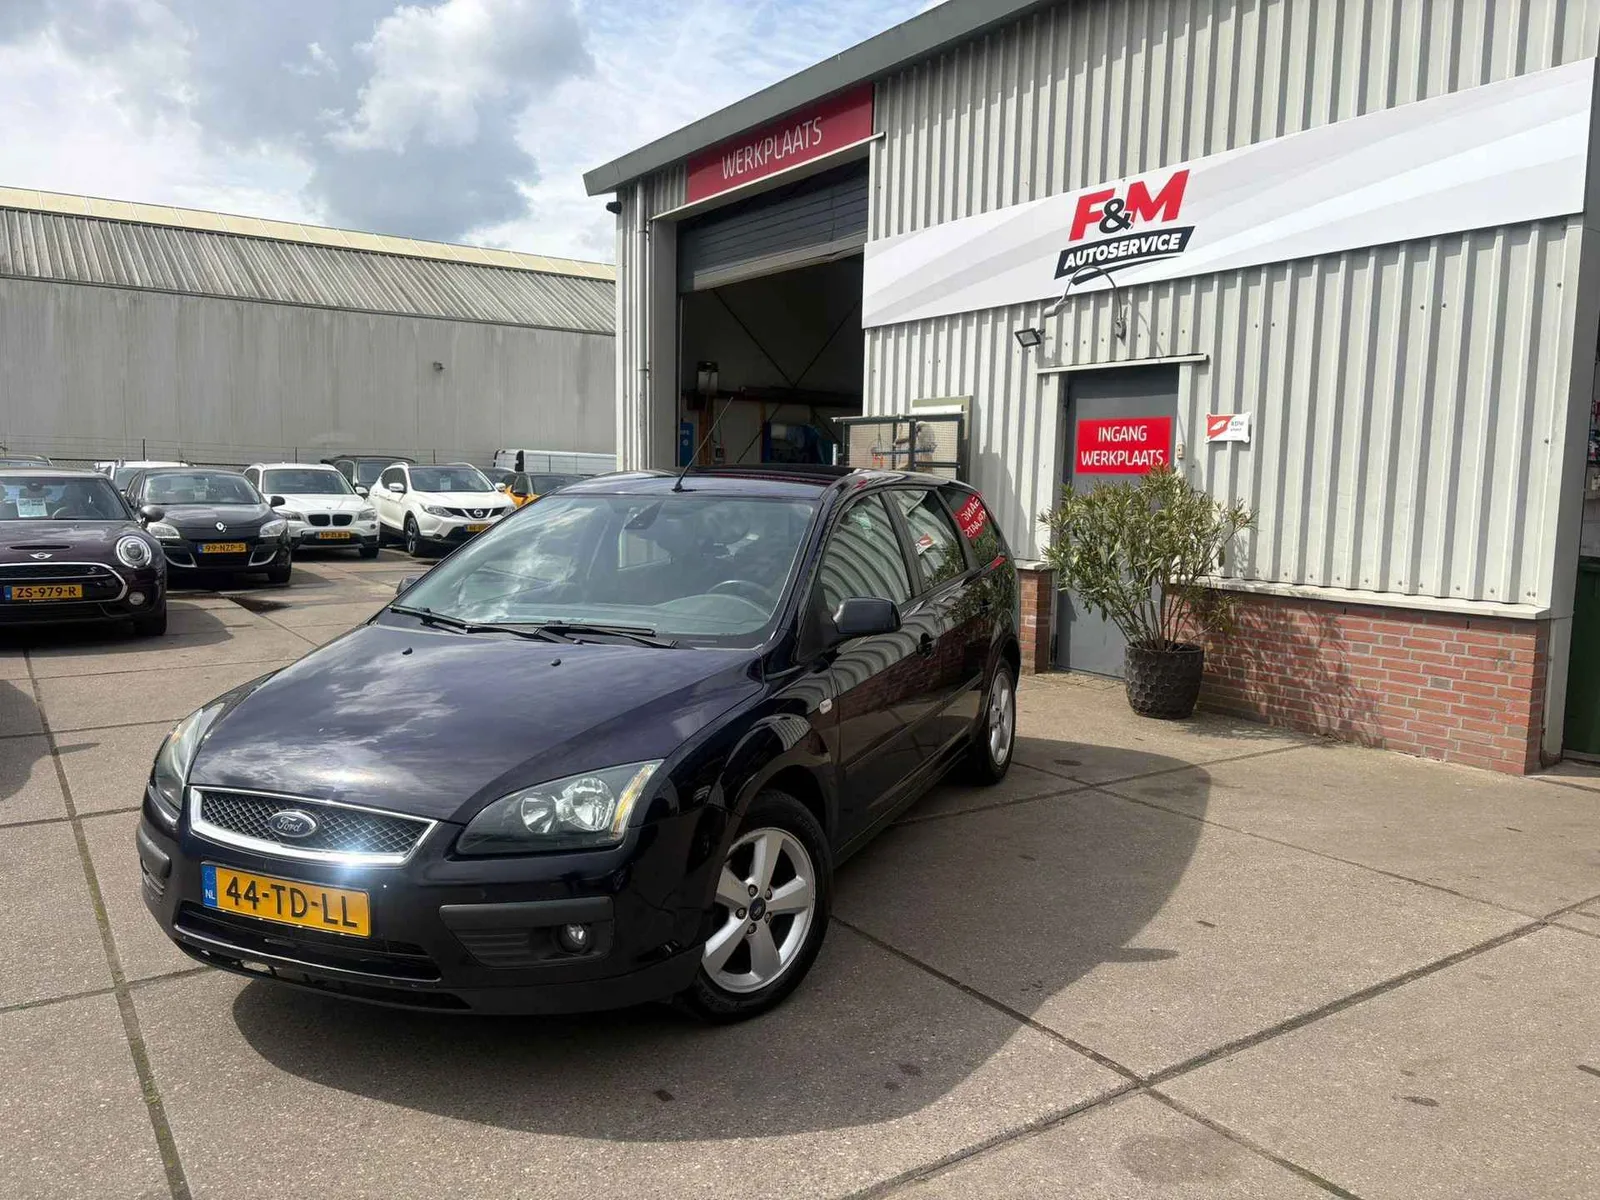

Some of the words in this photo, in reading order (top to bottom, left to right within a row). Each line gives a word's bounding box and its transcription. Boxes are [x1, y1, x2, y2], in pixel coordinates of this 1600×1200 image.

[721, 116, 822, 180] WERKPLAATS
[1068, 169, 1190, 241] F&M
[1063, 233, 1182, 270] AUTOSERVICE
[1097, 425, 1147, 442] INGANG
[1080, 449, 1164, 466] WERKPLAATS
[16, 586, 77, 598] ZS-979-R
[204, 888, 216, 900] NL
[226, 876, 358, 928] 44-TD-LL
